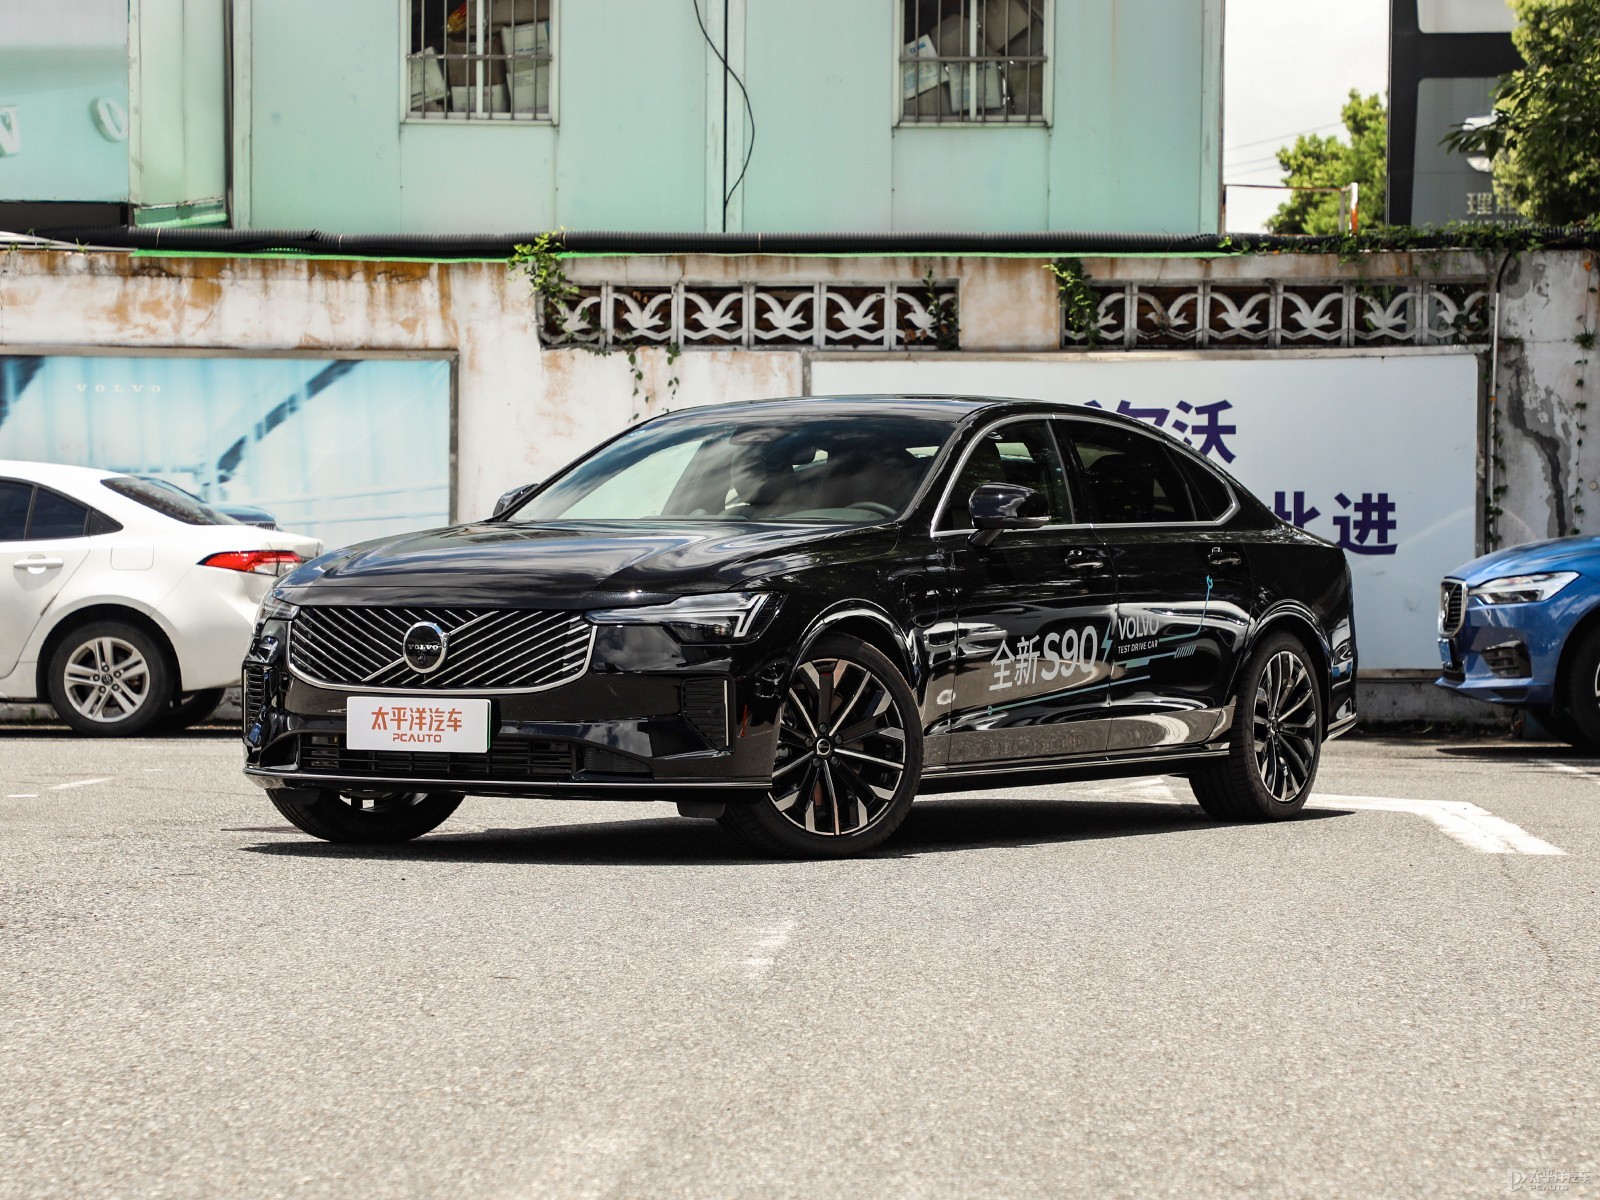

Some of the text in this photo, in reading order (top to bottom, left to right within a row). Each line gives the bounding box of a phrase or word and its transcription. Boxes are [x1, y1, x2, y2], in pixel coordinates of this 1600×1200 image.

[75, 383, 162, 393] VOLVO
[1118, 615, 1160, 640] VOLVO
[407, 642, 440, 651] VOLVO
[1118, 640, 1159, 654] TEST DRIVE CAR
[371, 706, 463, 732] 太平洋汽车
[392, 733, 442, 743] PCAUTO
